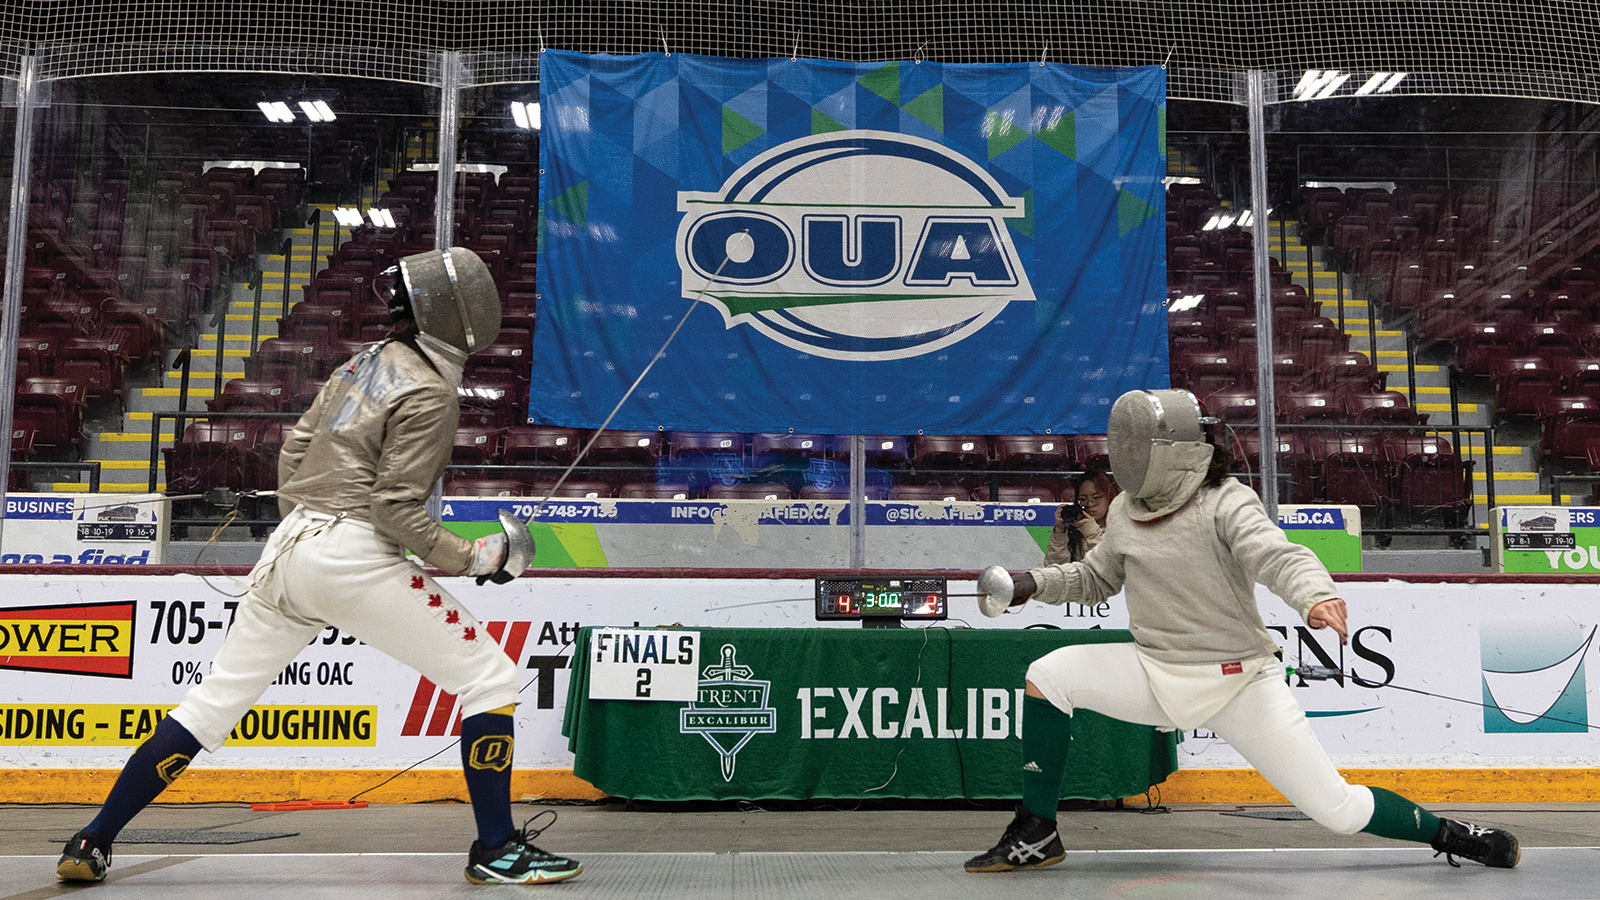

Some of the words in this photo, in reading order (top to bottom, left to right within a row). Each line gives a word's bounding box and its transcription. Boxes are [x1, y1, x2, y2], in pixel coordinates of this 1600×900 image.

[685, 210, 1019, 287] OUA
[7, 501, 73, 513] BUSINES
[93, 528, 114, 536] 10-19
[1506, 537, 1515, 545] 19
[1544, 537, 1552, 545] 17
[1555, 537, 1574, 545] 19-10
[838, 595, 850, 613] 4
[597, 634, 693, 664] FINALS
[317, 662, 353, 685] OAC
[636, 668, 651, 697] 2
[698, 690, 761, 708] TRENT
[689, 716, 768, 725] EXCALIBUR
